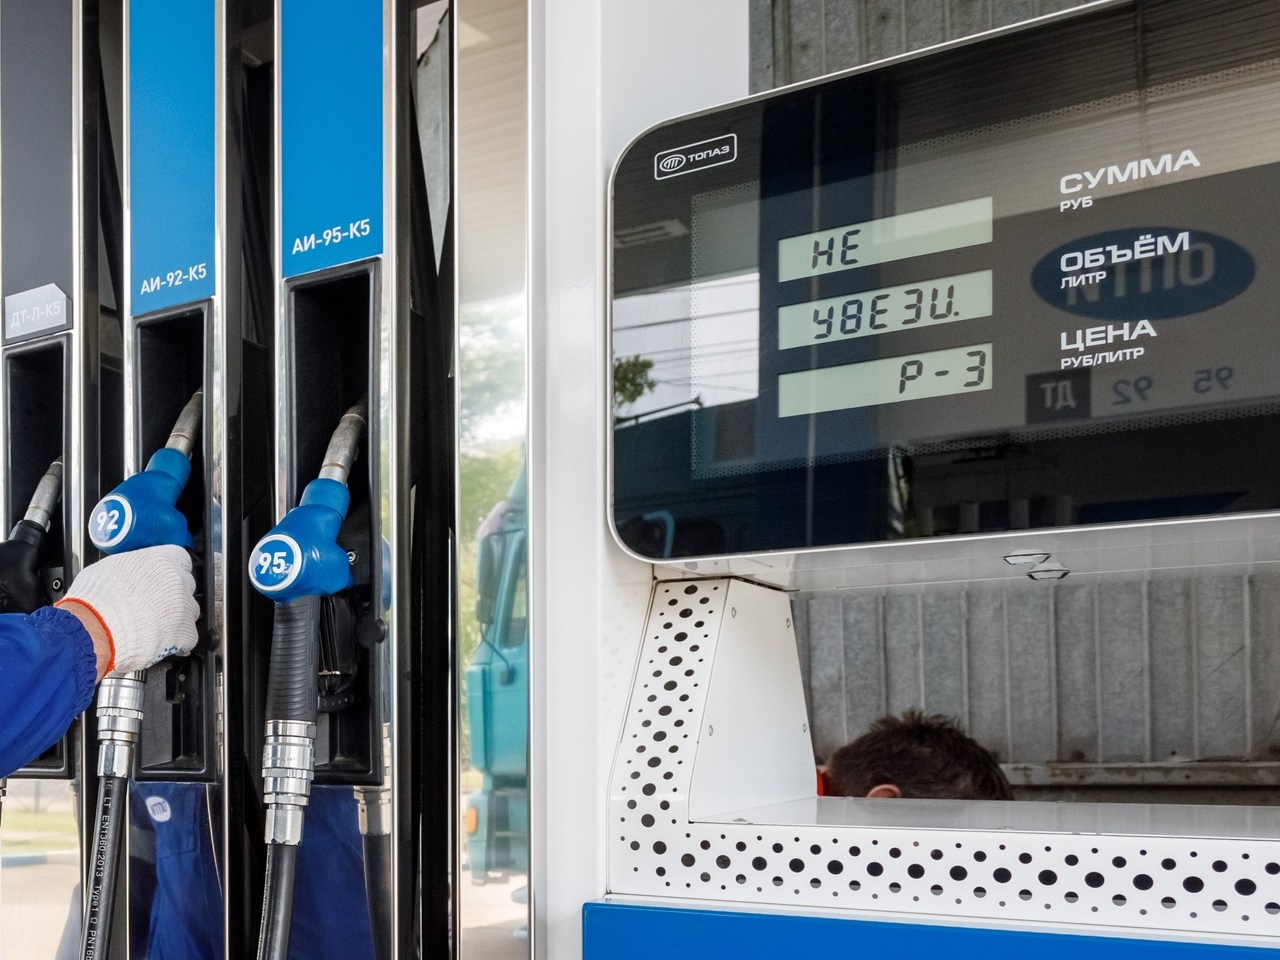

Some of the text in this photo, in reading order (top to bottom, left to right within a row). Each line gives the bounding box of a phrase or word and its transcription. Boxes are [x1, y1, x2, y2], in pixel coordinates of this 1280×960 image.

[687, 145, 730, 162] ТОПАЗ
[1059, 149, 1201, 194] СУММА
[1059, 195, 1093, 212] РУБ
[291, 218, 371, 255] АИ-95-К5
[1060, 231, 1190, 272] ОБЪЁМ
[140, 262, 207, 295] АИ-92-К5
[1060, 270, 1107, 289] ЛИТР
[10, 300, 61, 329] ДТ-Л-К5
[1060, 319, 1157, 351] ЦЕНА
[1060, 347, 1145, 369] РУБ/ЛИТР
[96, 509, 120, 531] 92
[258, 551, 287, 575] 95
[103, 797, 112, 809] LT
[91, 884, 102, 911] Type1
